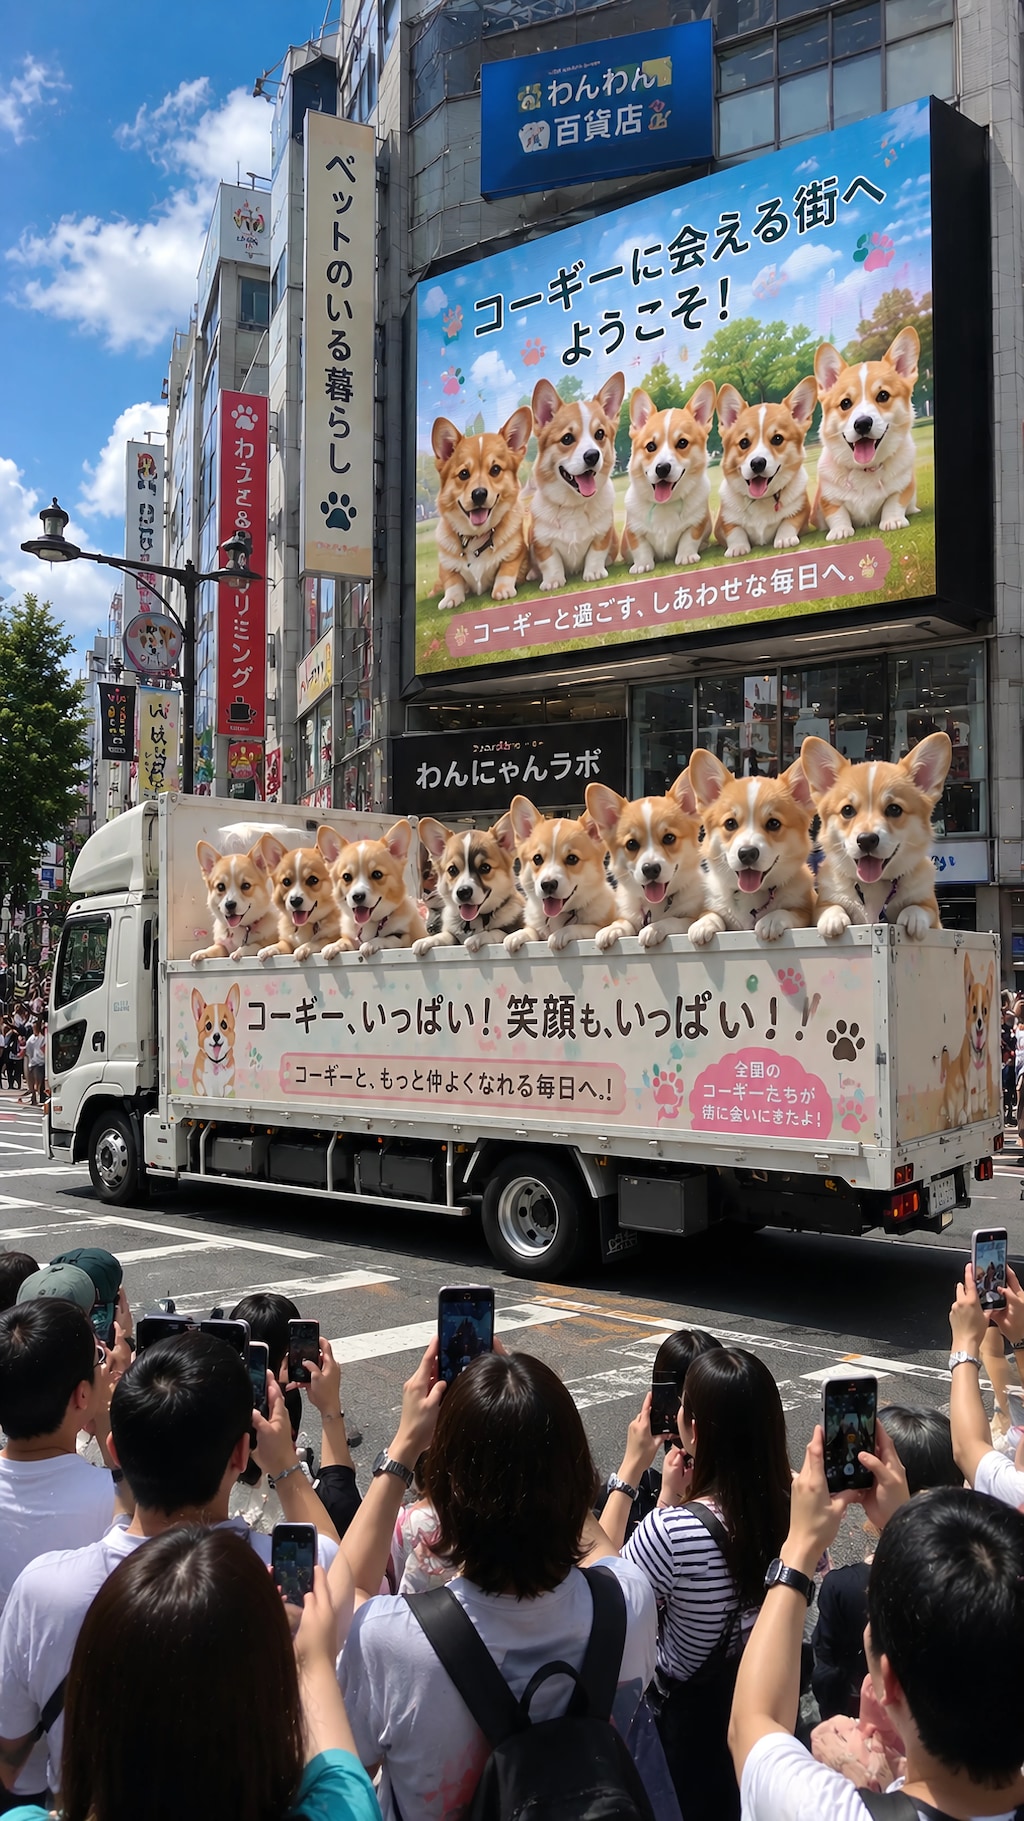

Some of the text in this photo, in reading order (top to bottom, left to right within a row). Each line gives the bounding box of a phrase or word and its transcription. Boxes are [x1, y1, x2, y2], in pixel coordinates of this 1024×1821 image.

[548, 67, 655, 107] わんわん
[554, 103, 643, 147] 百貨店
[475, 176, 885, 335] コーギーに会える街へ
[562, 277, 730, 367] ようこそ！
[703, 1082, 816, 1104] コーギーたちが
